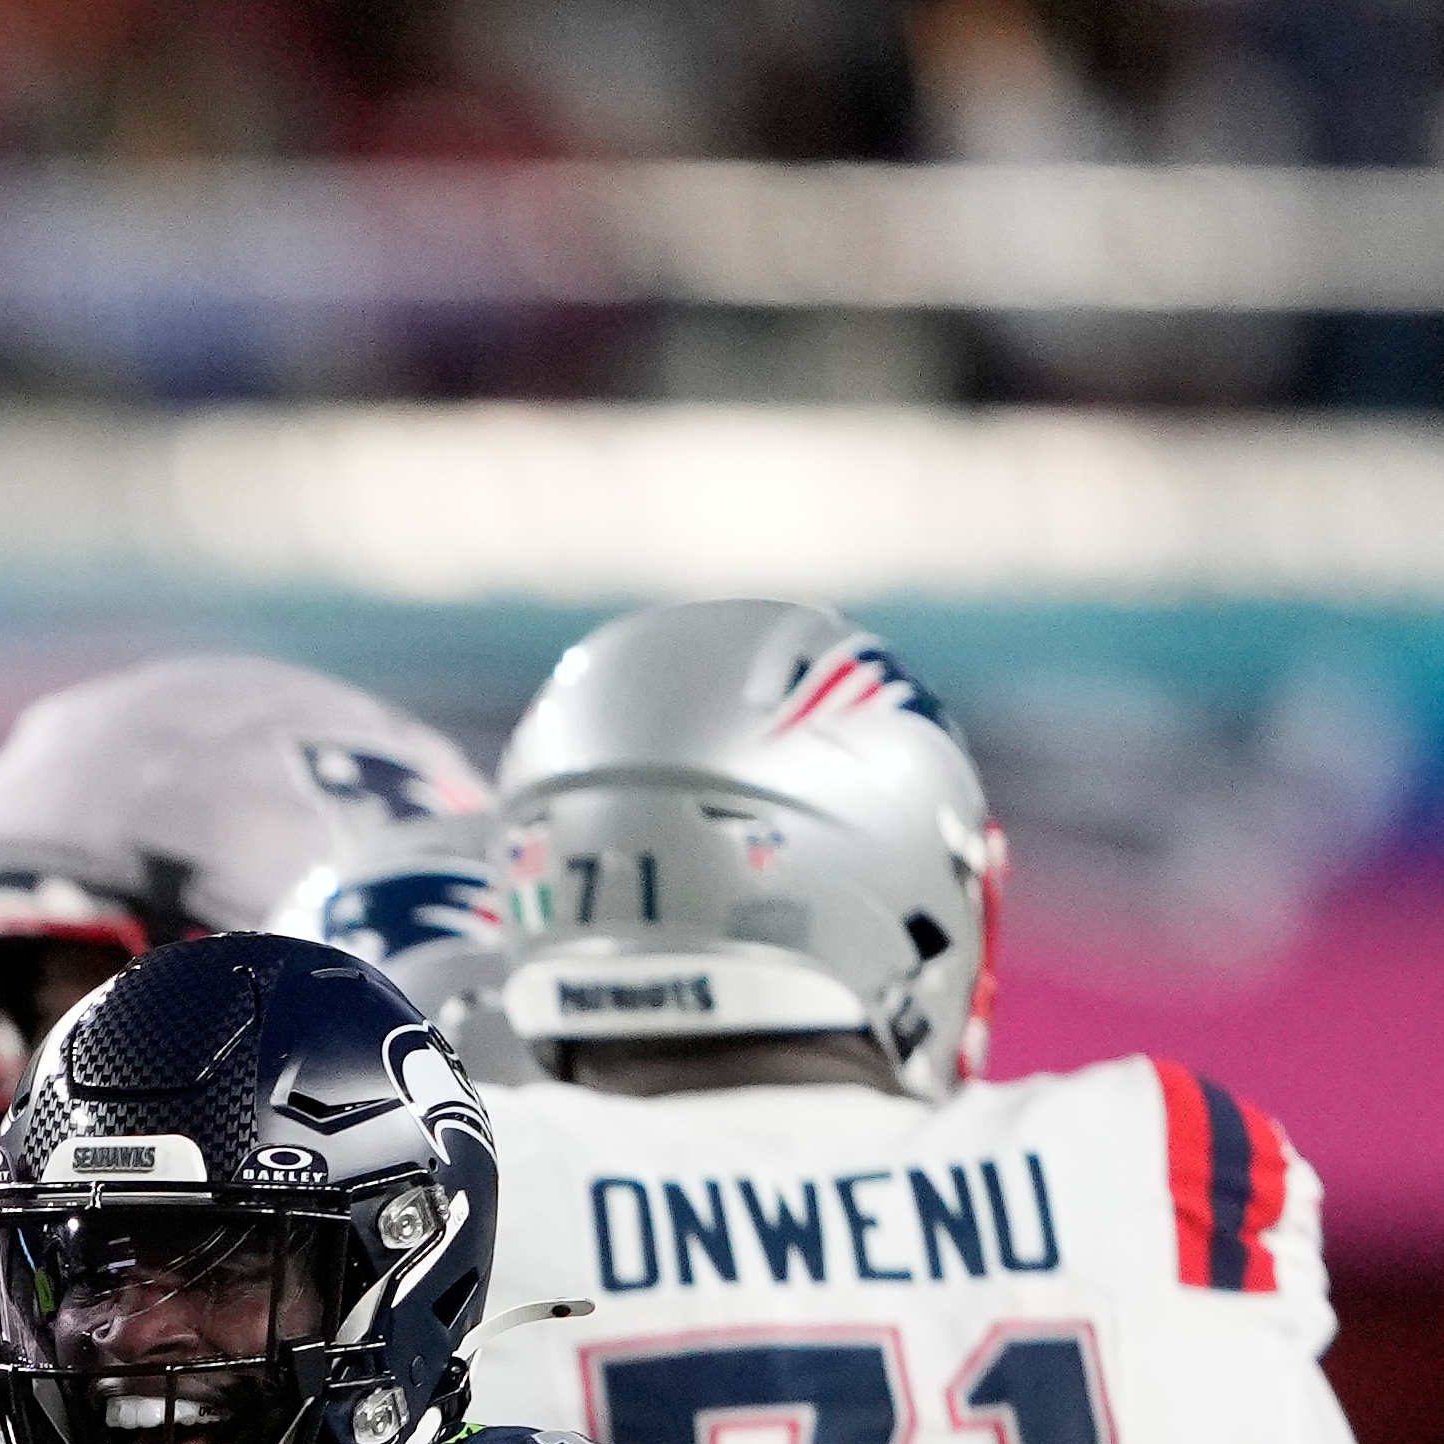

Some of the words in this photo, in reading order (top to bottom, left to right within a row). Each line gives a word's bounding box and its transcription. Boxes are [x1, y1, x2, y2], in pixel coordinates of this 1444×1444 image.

[566, 853, 658, 925] 71
[72, 1146, 156, 1171] SEAHAWKS
[242, 1168, 324, 1183] OAKLEY
[589, 1150, 1061, 1295] ONWENU
